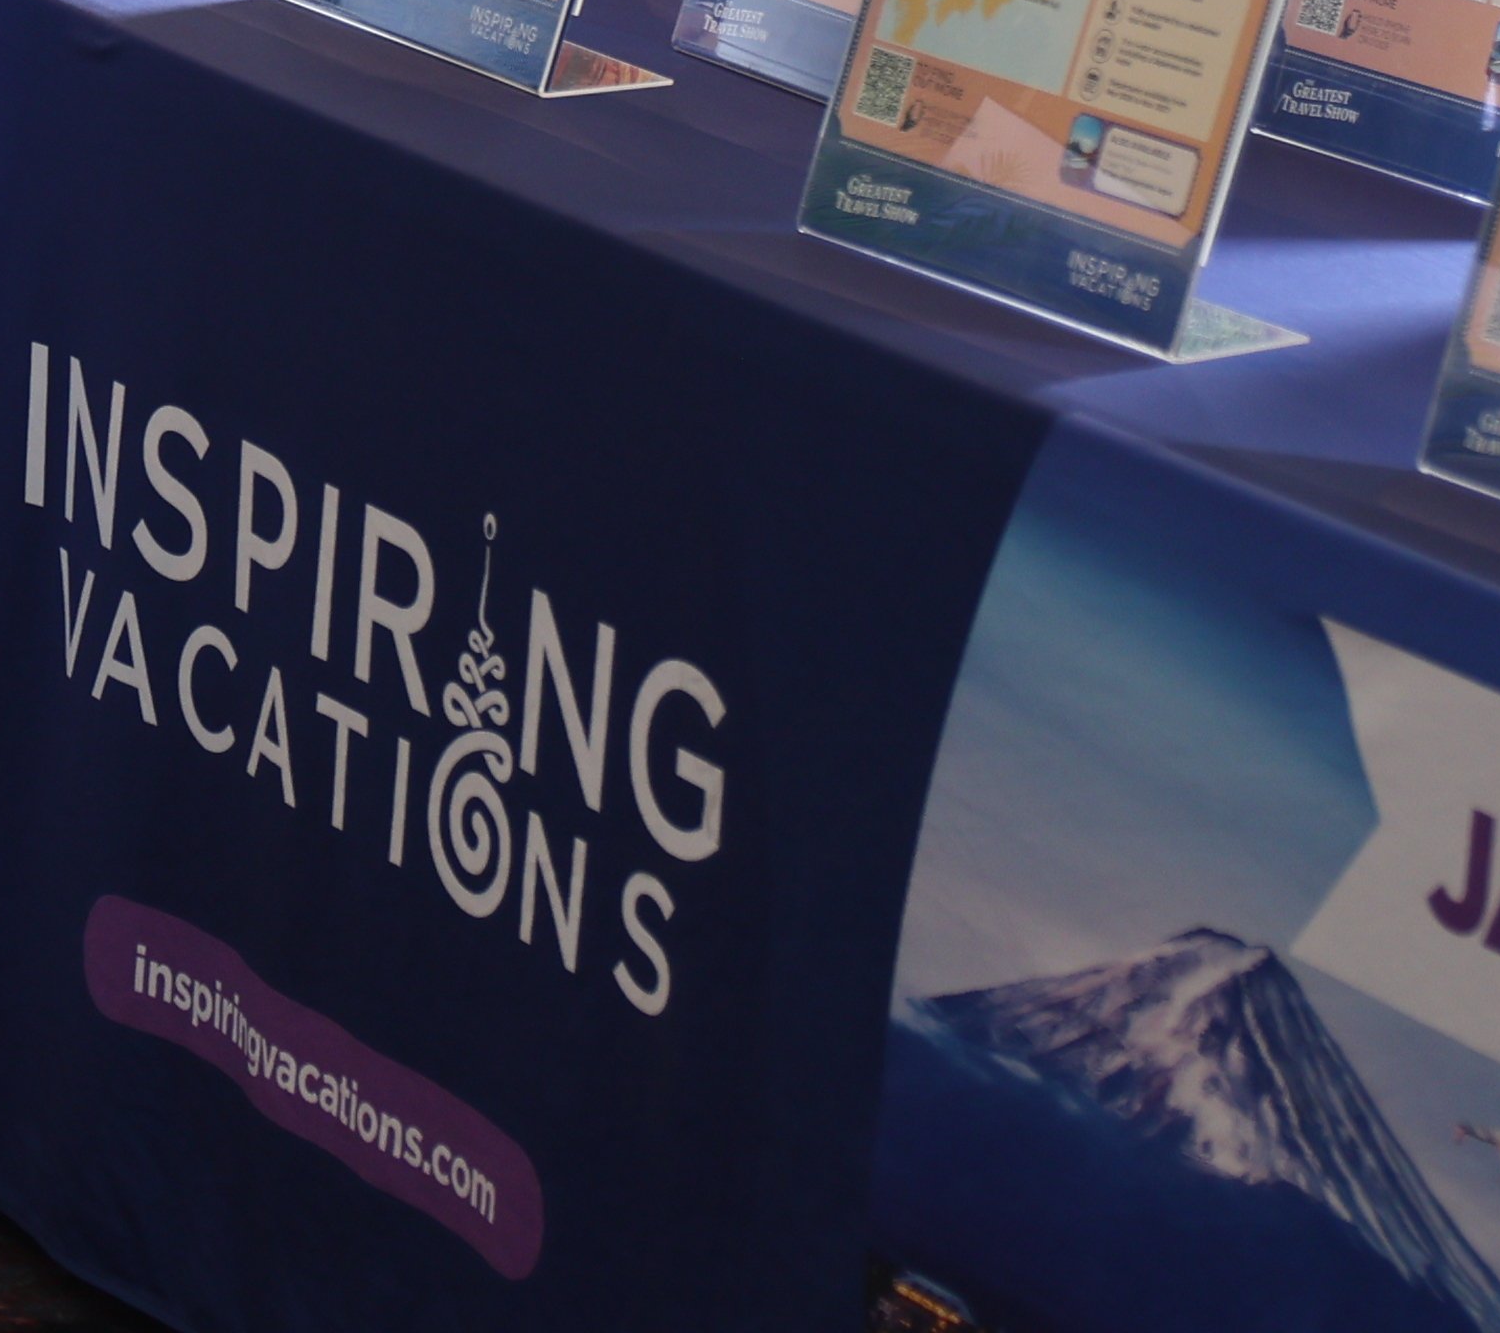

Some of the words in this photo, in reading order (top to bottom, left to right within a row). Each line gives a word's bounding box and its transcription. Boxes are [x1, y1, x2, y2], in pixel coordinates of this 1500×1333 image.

[703, 13, 738, 37] TRAVEL
[713, 2, 764, 24] GREATEST
[1293, 81, 1352, 106] GREATEST
[1282, 94, 1324, 117] TRAVEL
[1324, 104, 1360, 124] SHOW
[847, 175, 913, 205] GREATEST
[835, 190, 881, 217] TRAVEL
[881, 202, 920, 226] SHOW
[24, 341, 727, 863] INSPIRING
[58, 546, 676, 1017] VACATIONS
[134, 943, 495, 1224] inspiringvacations.com
